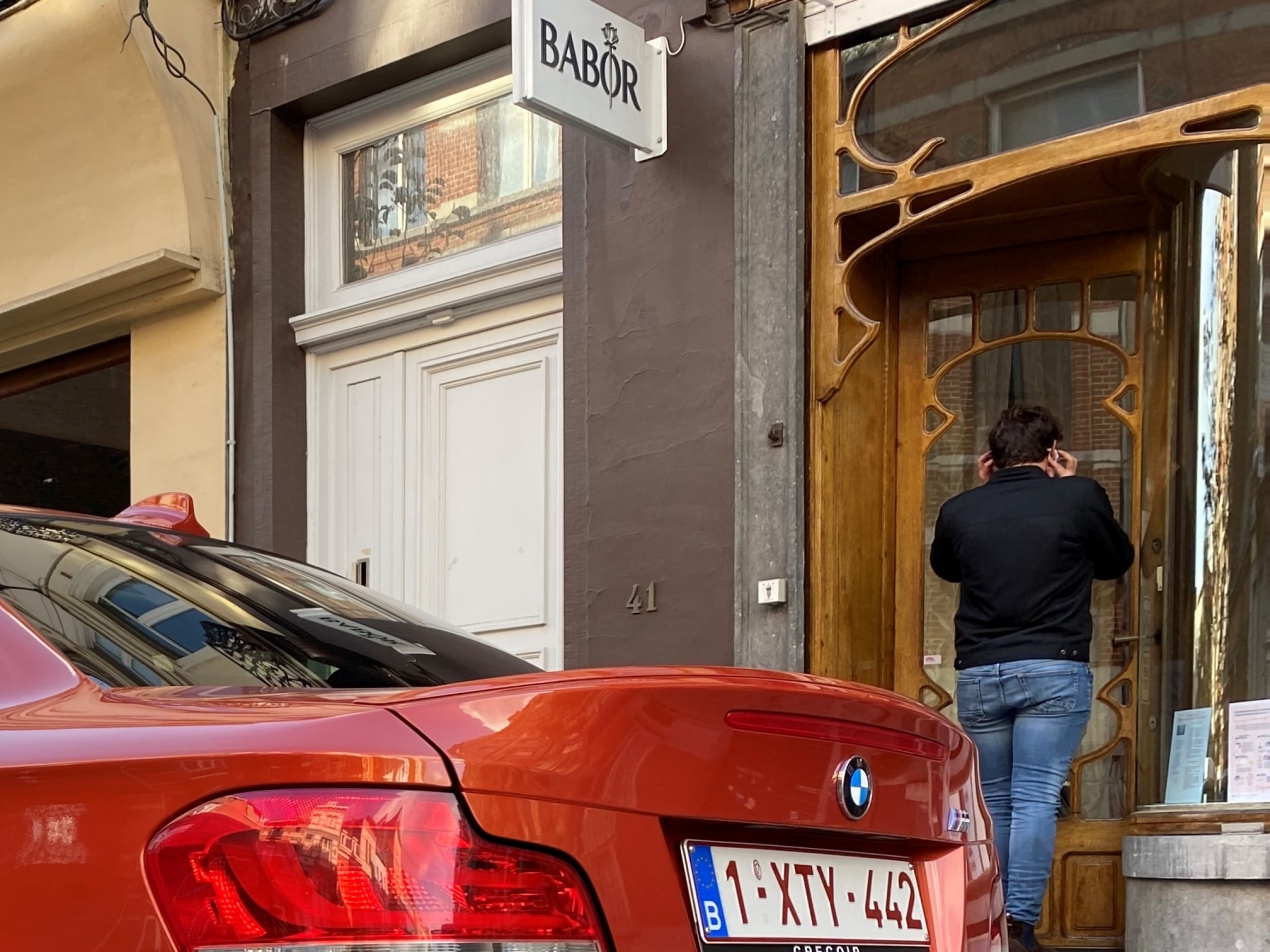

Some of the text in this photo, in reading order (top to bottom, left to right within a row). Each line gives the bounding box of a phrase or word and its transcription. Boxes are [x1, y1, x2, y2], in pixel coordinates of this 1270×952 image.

[540, 18, 642, 111] BABOR
[626, 581, 656, 614] 41
[704, 900, 723, 932] B
[725, 860, 923, 930] 1-XTY-442
